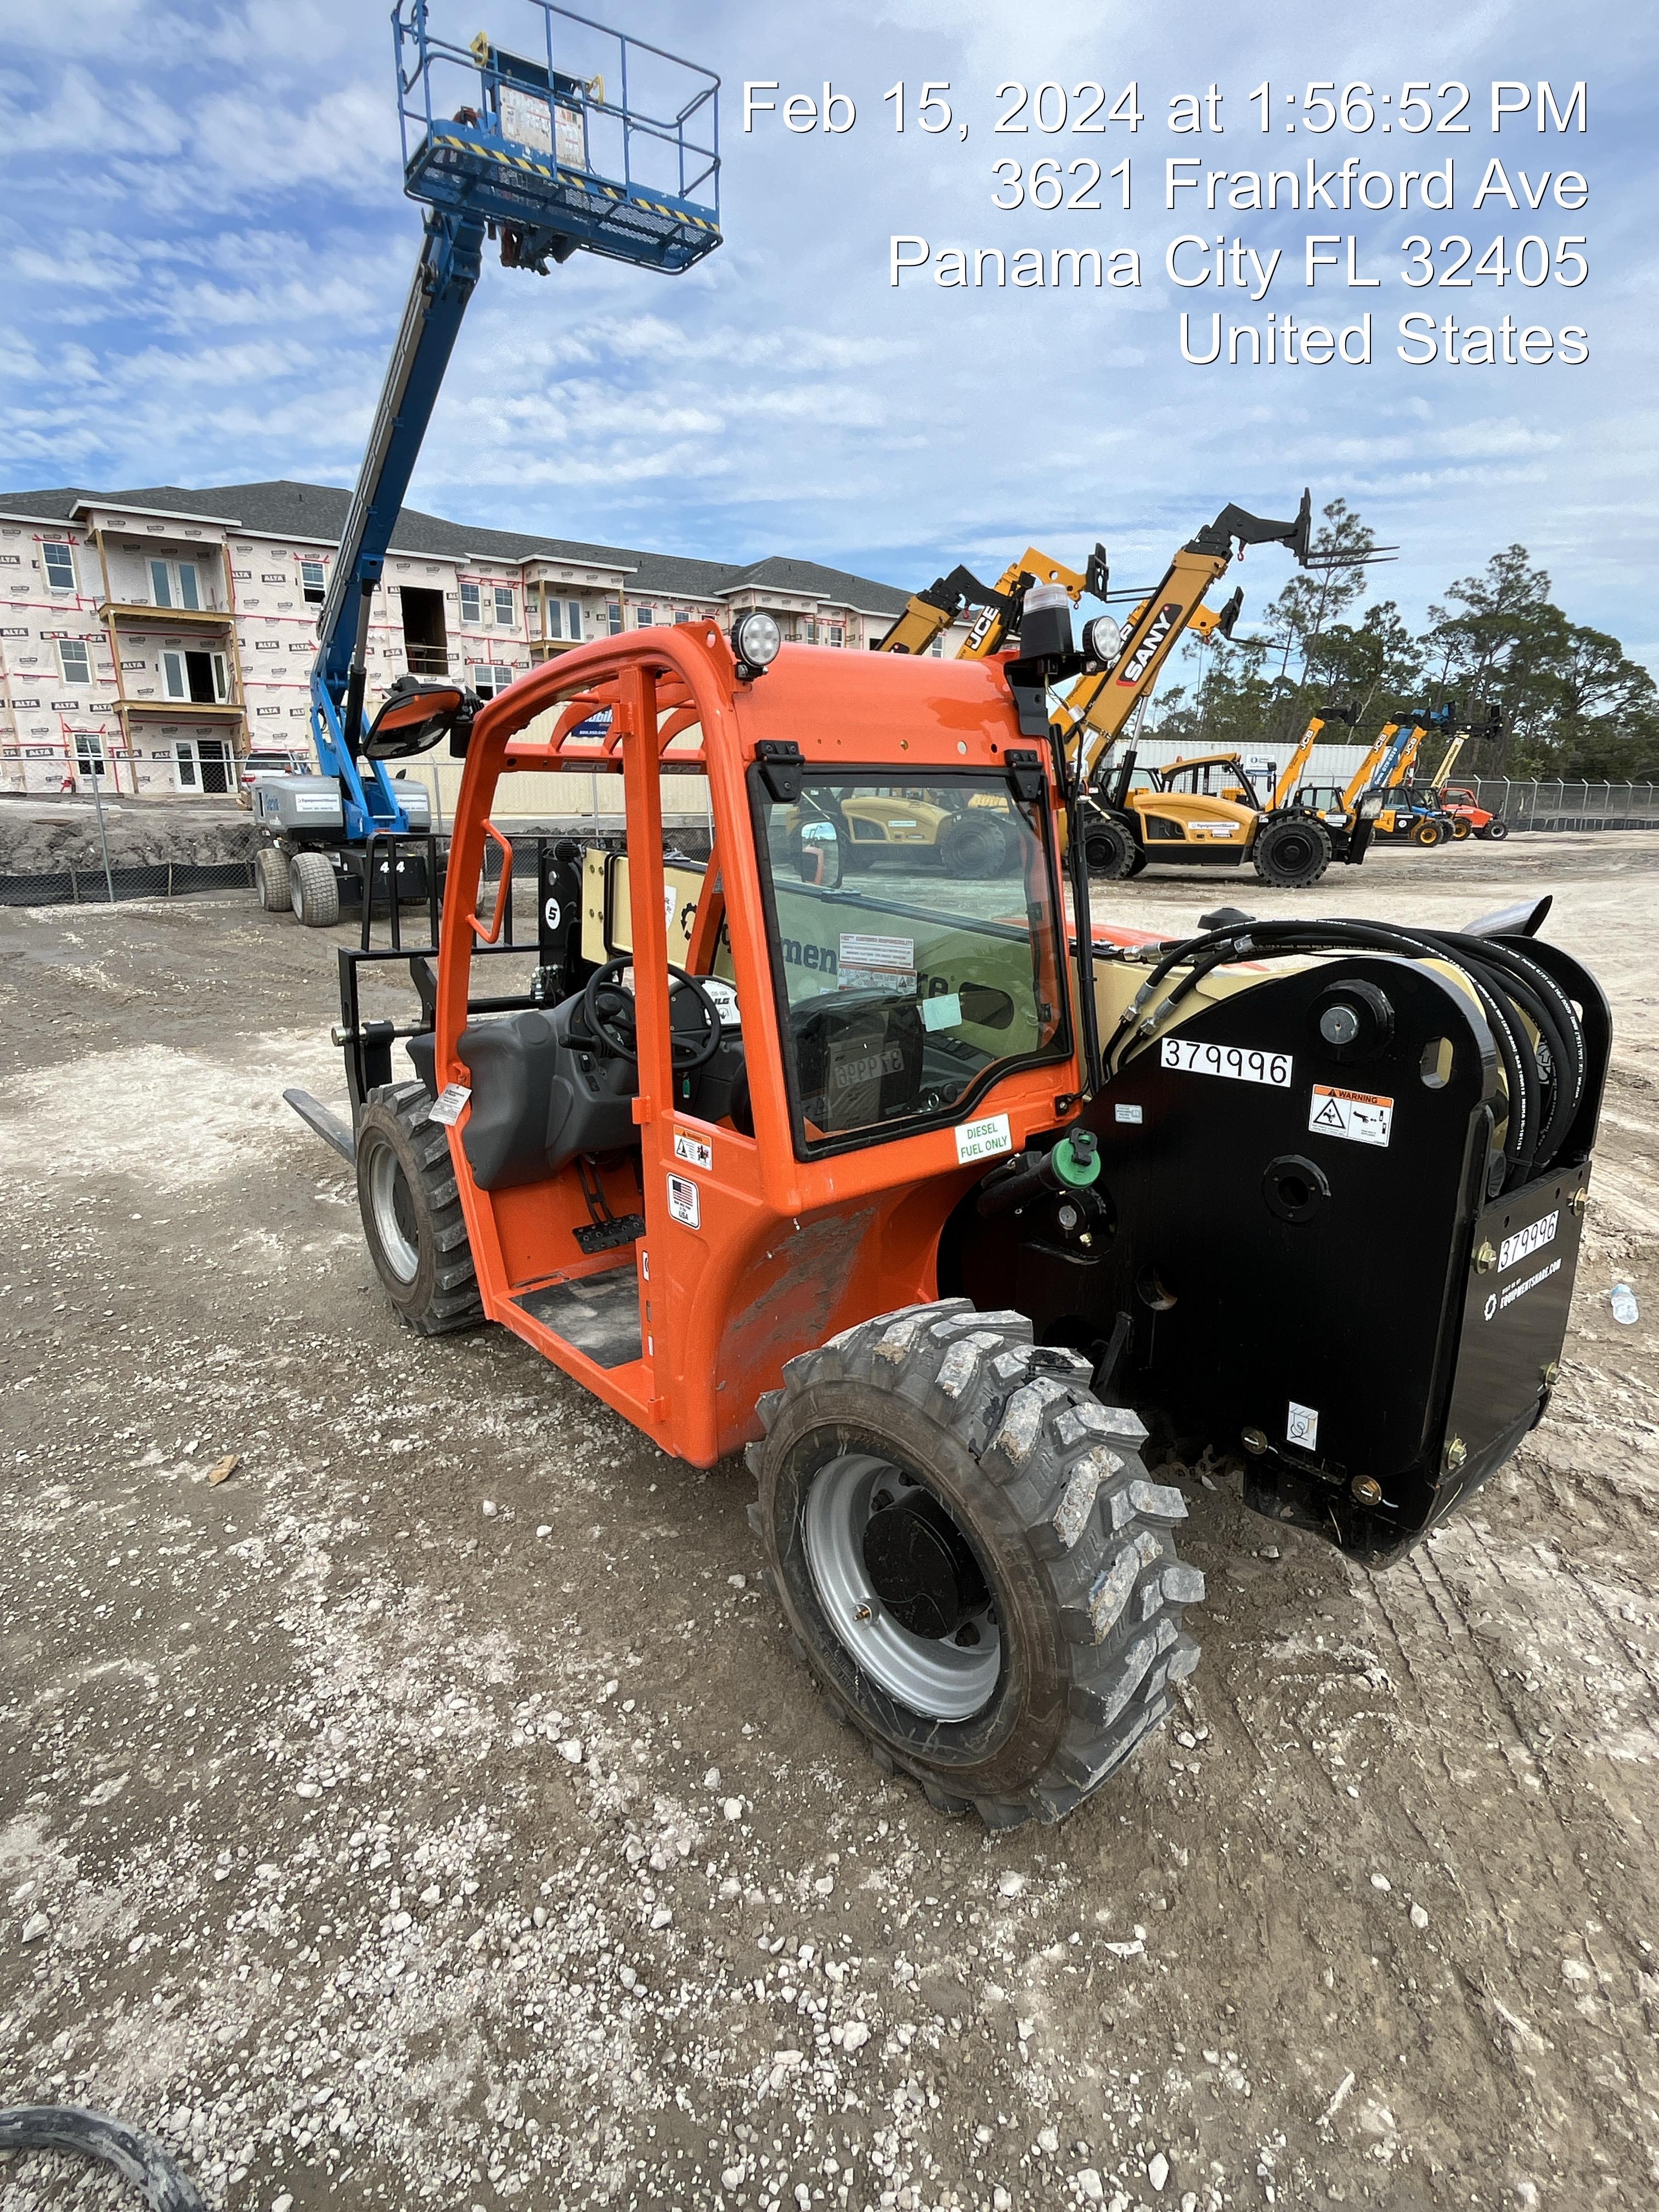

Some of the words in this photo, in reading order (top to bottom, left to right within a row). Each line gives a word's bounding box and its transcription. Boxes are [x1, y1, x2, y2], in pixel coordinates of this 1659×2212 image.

[1124, 611, 1171, 682] SANY
[1300, 730, 1314, 751] JCB
[1374, 733, 1387, 754] JCB
[1405, 737, 1418, 756] JCB
[548, 906, 557, 921] 5
[1164, 1039, 1289, 1085] 379996
[1339, 1090, 1378, 1104] WARNING
[967, 1122, 998, 1139] DIESEL
[961, 1143, 984, 1158] FUEL
[985, 1135, 1008, 1151] ONLY
[678, 1210, 689, 1221] USA
[1500, 1212, 1556, 1268] 379996
